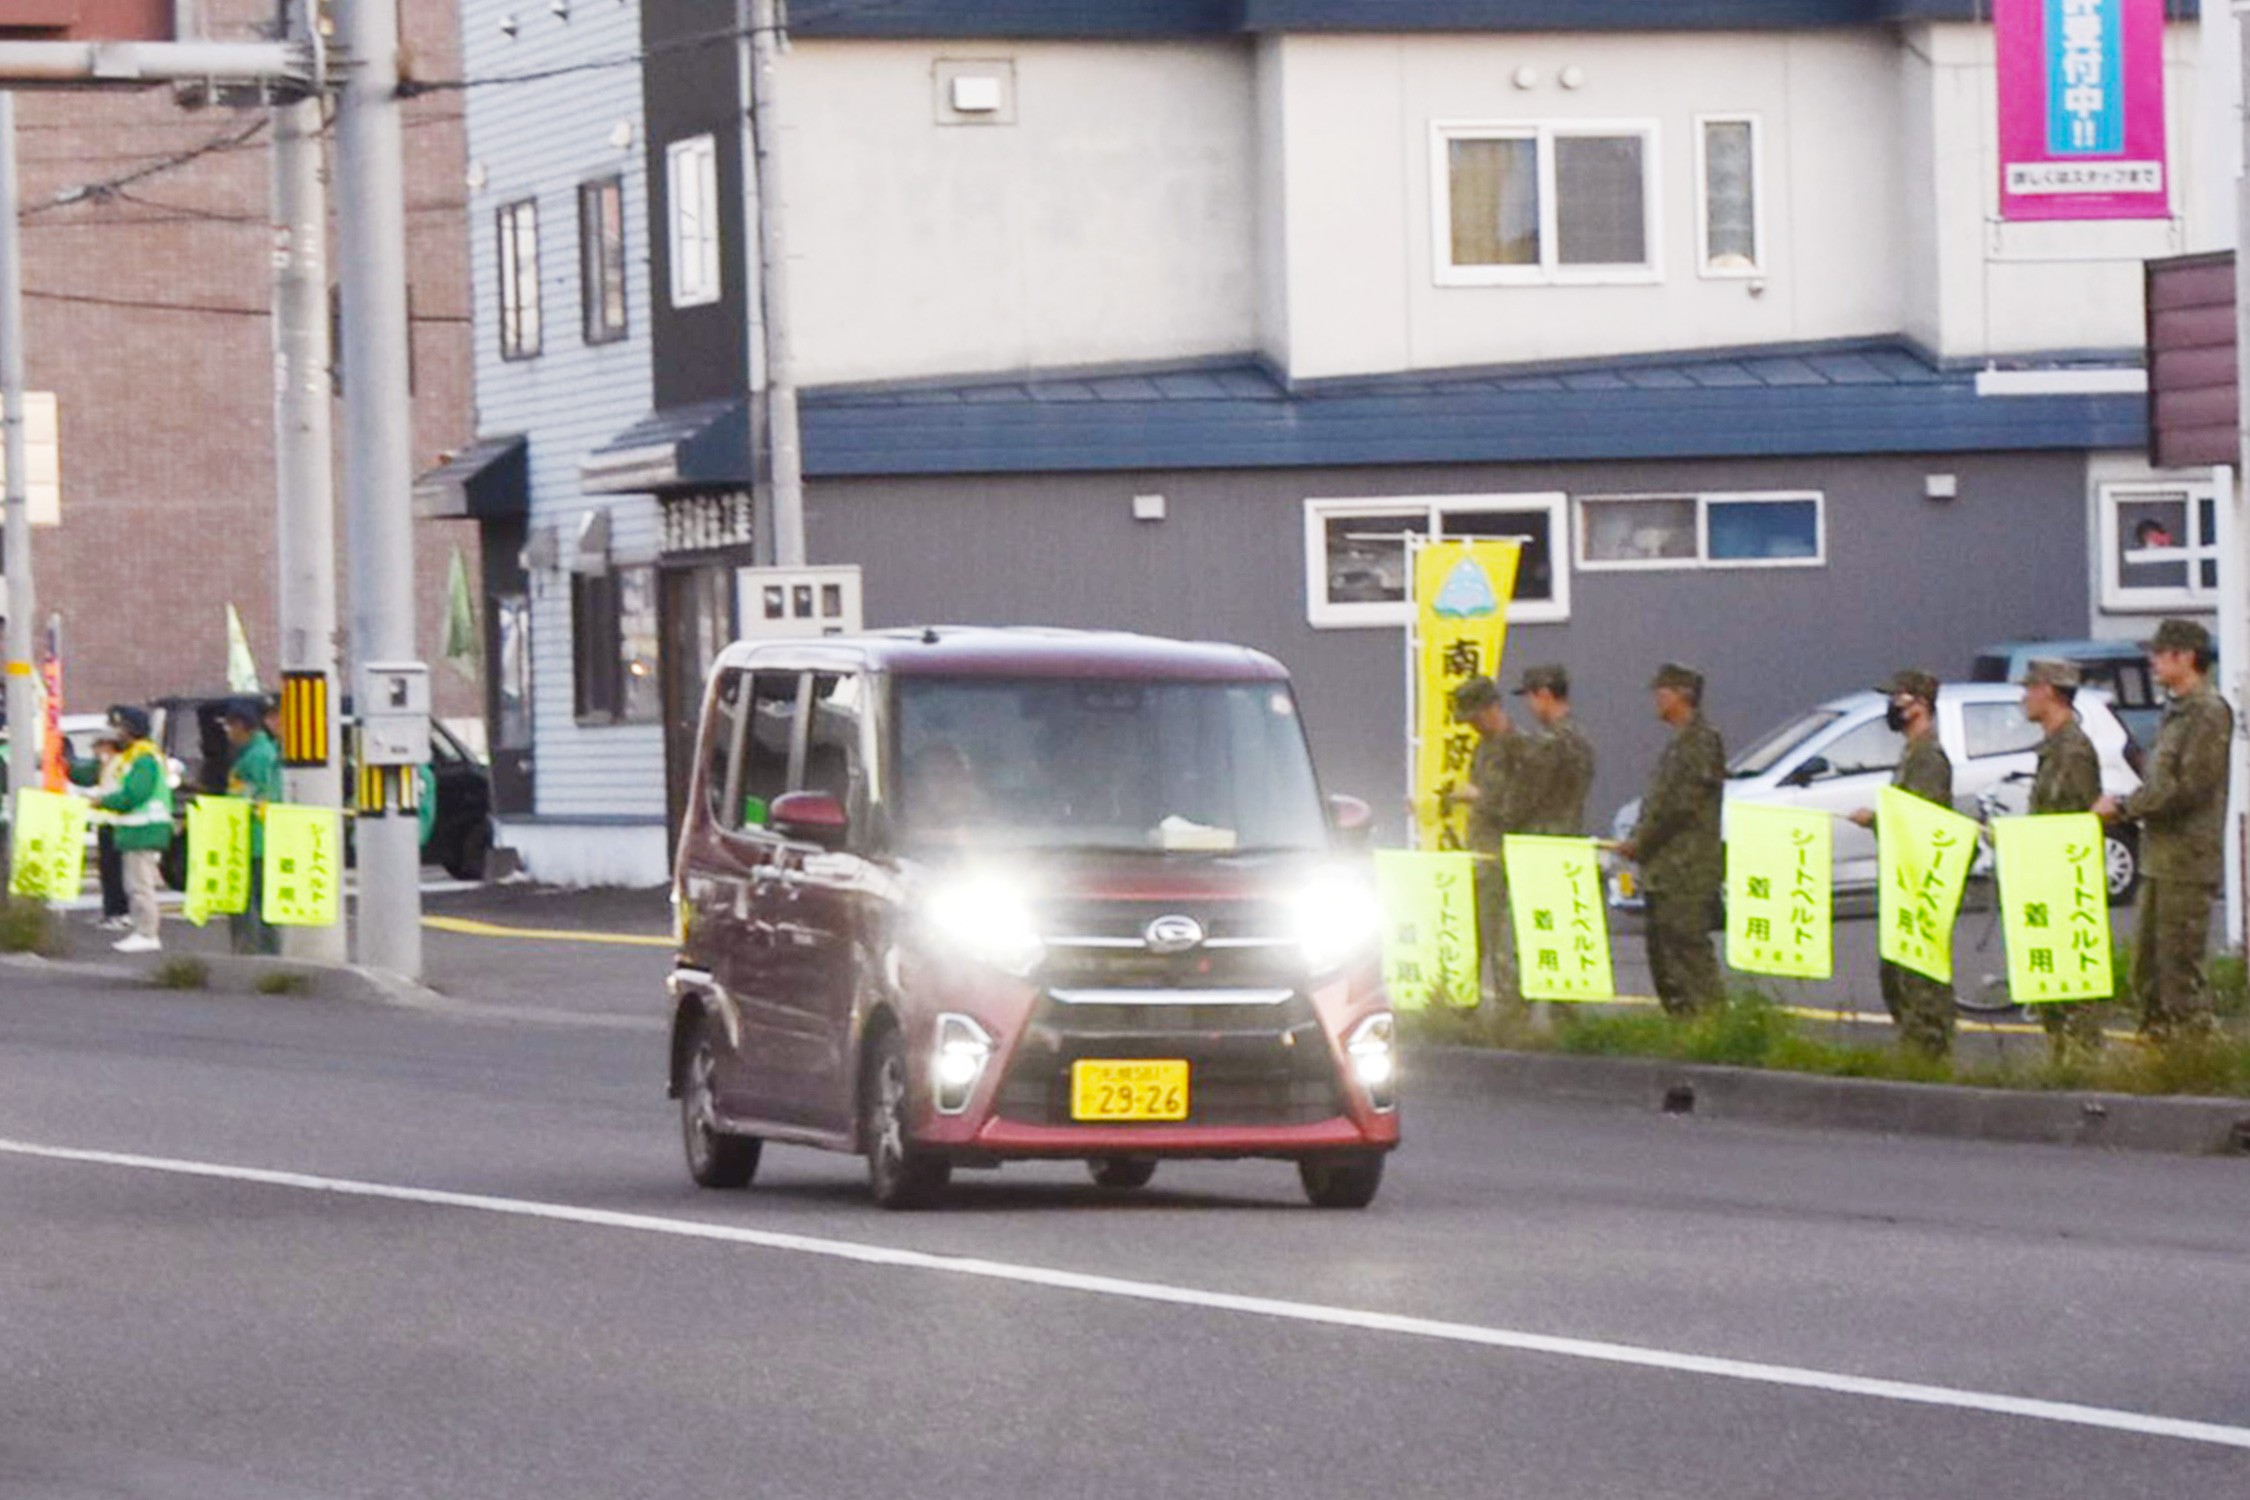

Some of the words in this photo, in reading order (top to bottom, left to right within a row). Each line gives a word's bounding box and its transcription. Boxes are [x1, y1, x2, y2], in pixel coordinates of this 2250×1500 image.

[1562, 859, 1597, 972] シートベルト
[1744, 874, 1772, 943] 着用
[1790, 827, 1816, 946] シートベルト
[2065, 842, 2100, 973] シートベルト
[1532, 908, 1560, 972] 着用
[2023, 901, 2055, 974] 着用
